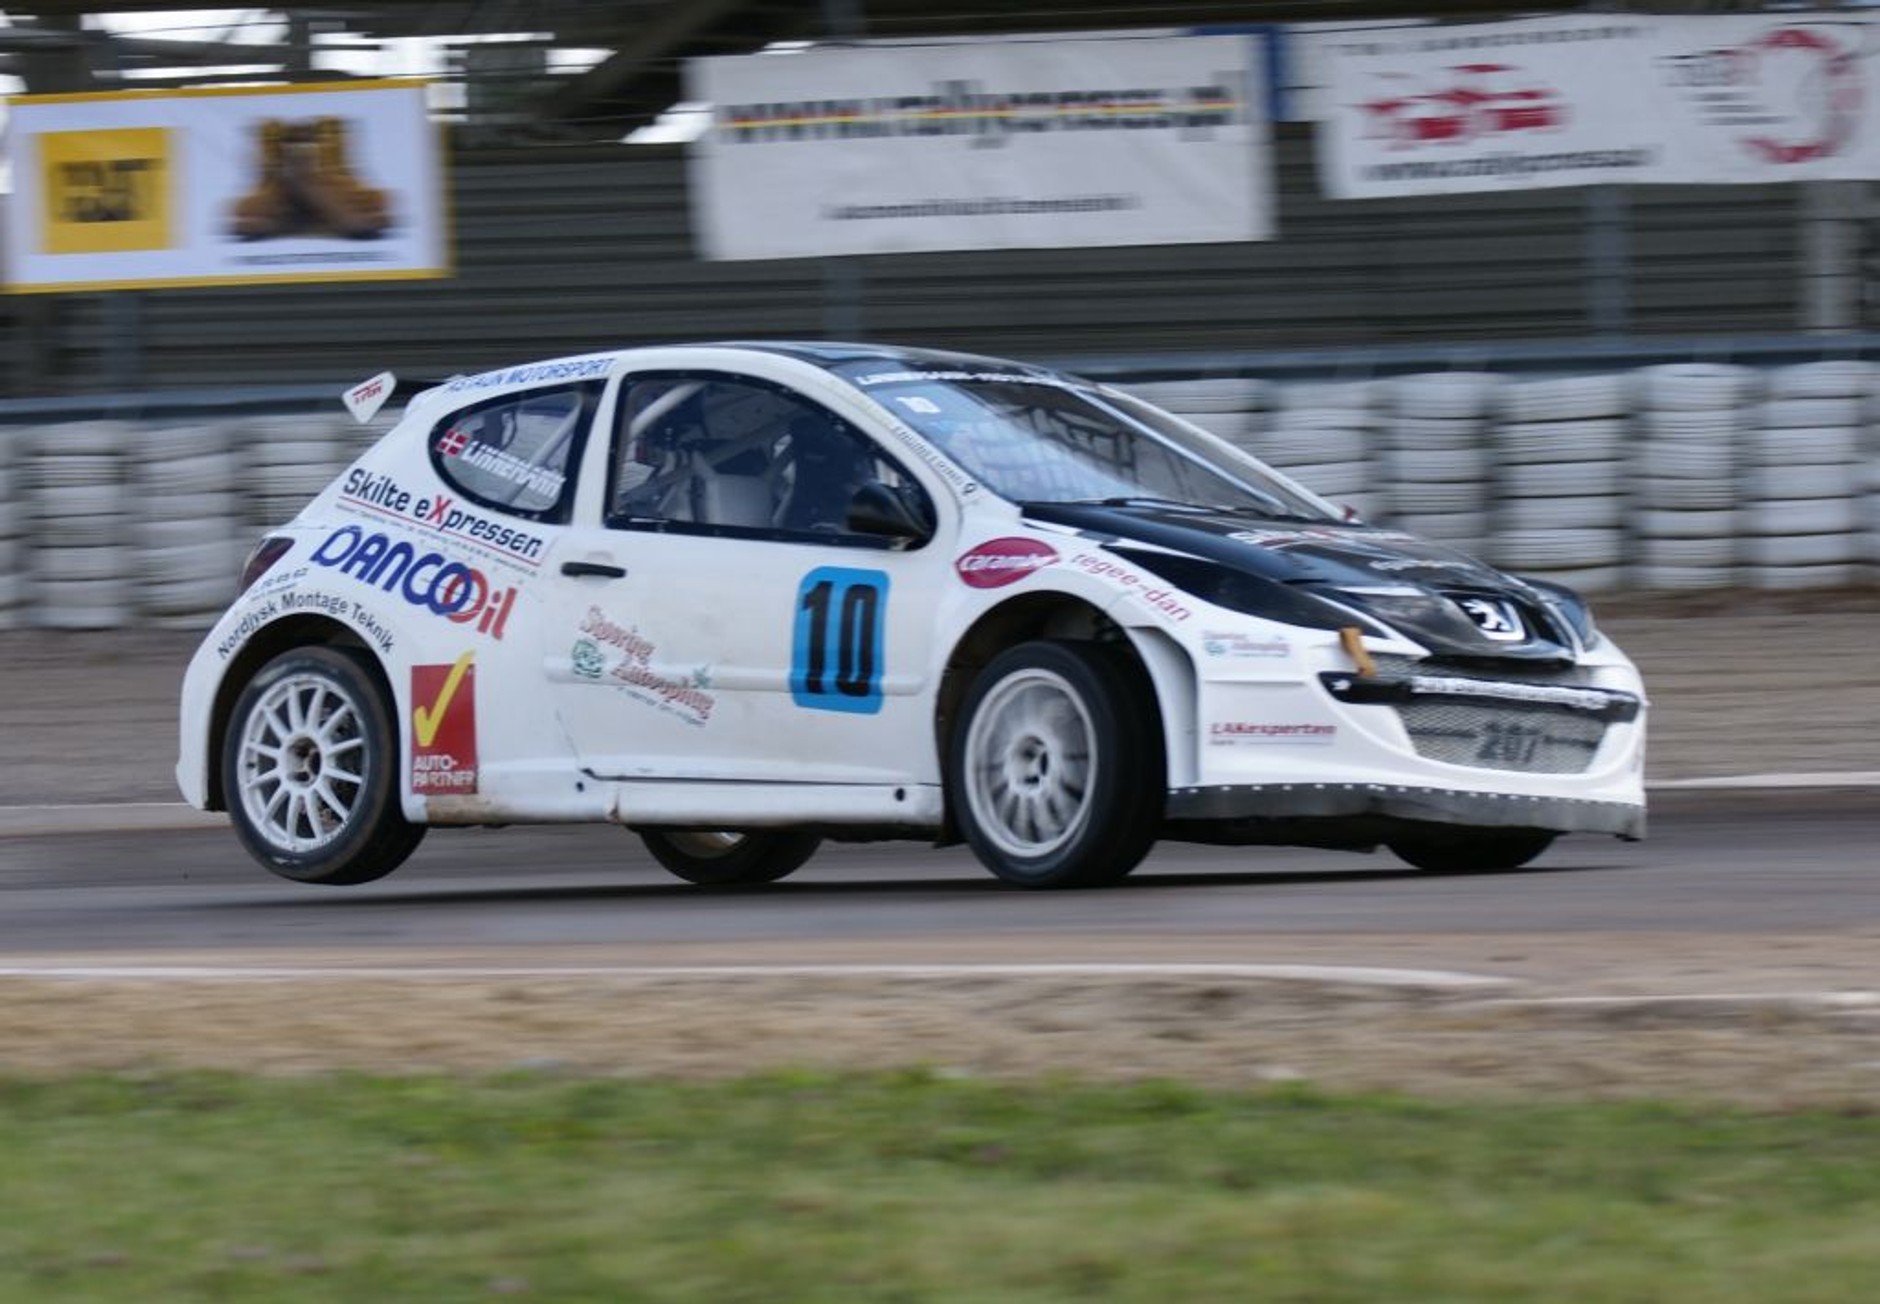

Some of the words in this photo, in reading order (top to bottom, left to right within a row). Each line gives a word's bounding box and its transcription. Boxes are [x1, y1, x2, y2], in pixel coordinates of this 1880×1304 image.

[343, 468, 411, 511] Skilte
[414, 495, 543, 558] eXpressen
[217, 601, 278, 659] Nordjysk
[281, 591, 348, 615] Montage
[351, 602, 395, 653] Teknik
[802, 580, 878, 697] 10
[413, 754, 459, 771] AUTO-
